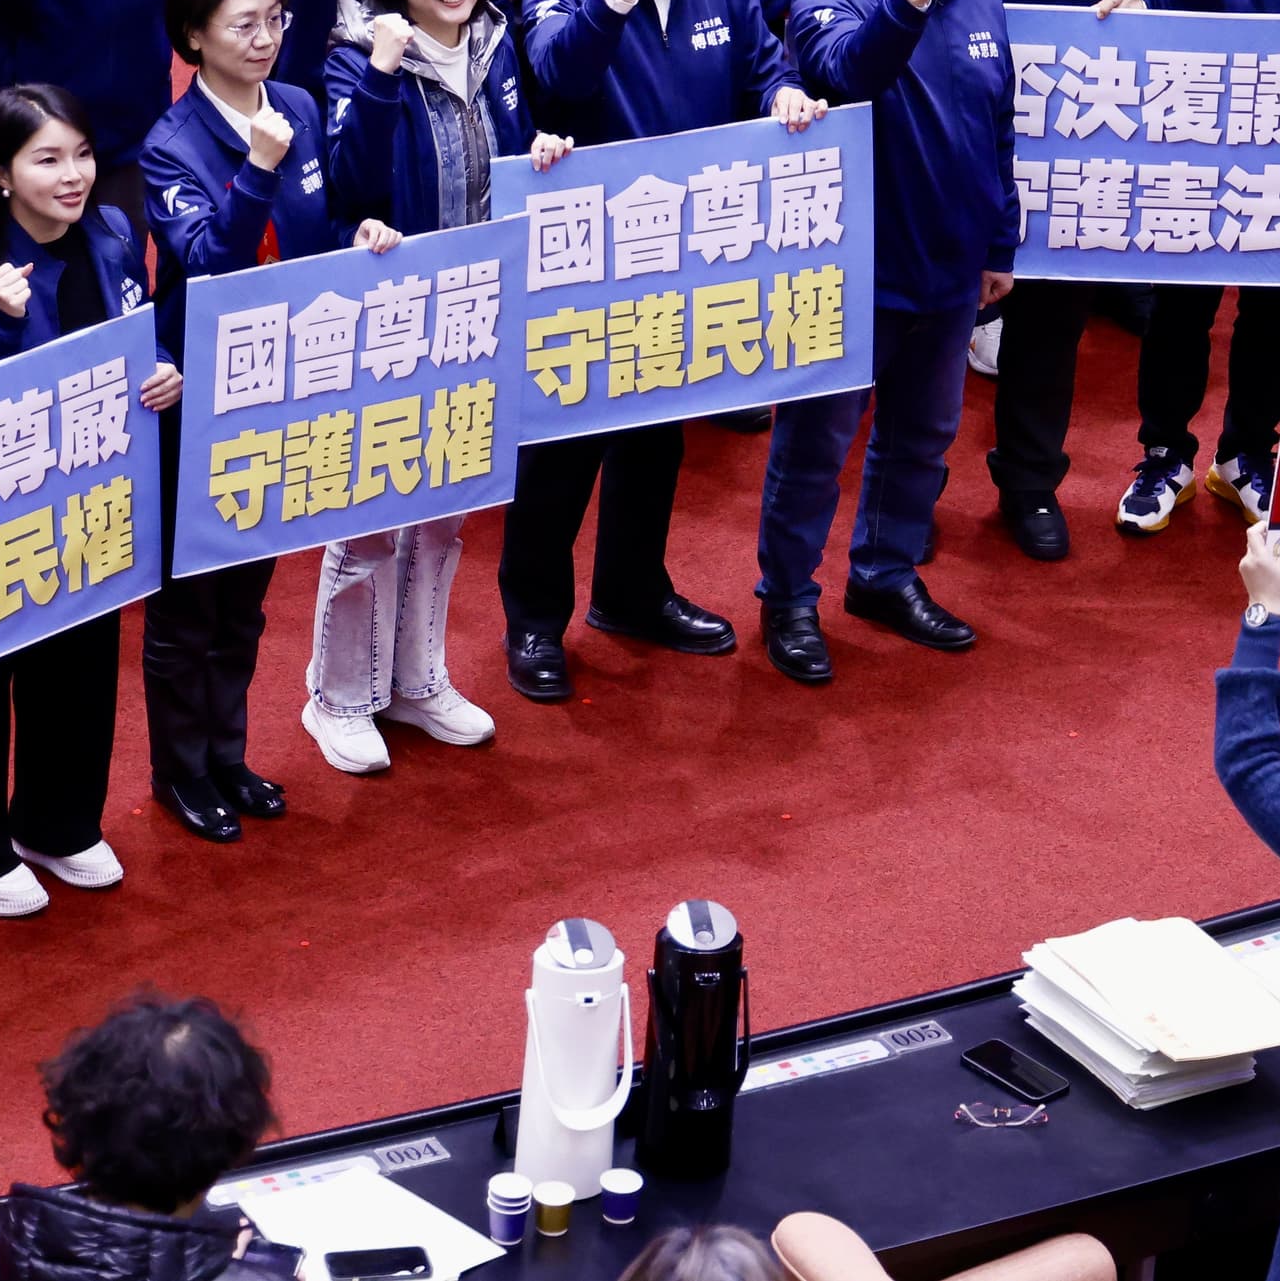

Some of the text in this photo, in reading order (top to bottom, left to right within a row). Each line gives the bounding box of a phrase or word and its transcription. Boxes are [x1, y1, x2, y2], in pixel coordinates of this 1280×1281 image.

[527, 147, 845, 293] 國會尊嚴
[214, 259, 500, 415] 國會尊嚴
[526, 264, 844, 406] 守護民權
[209, 378, 495, 531] 守護民權
[891, 1024, 942, 1048] 005
[385, 1142, 440, 1166] 004
